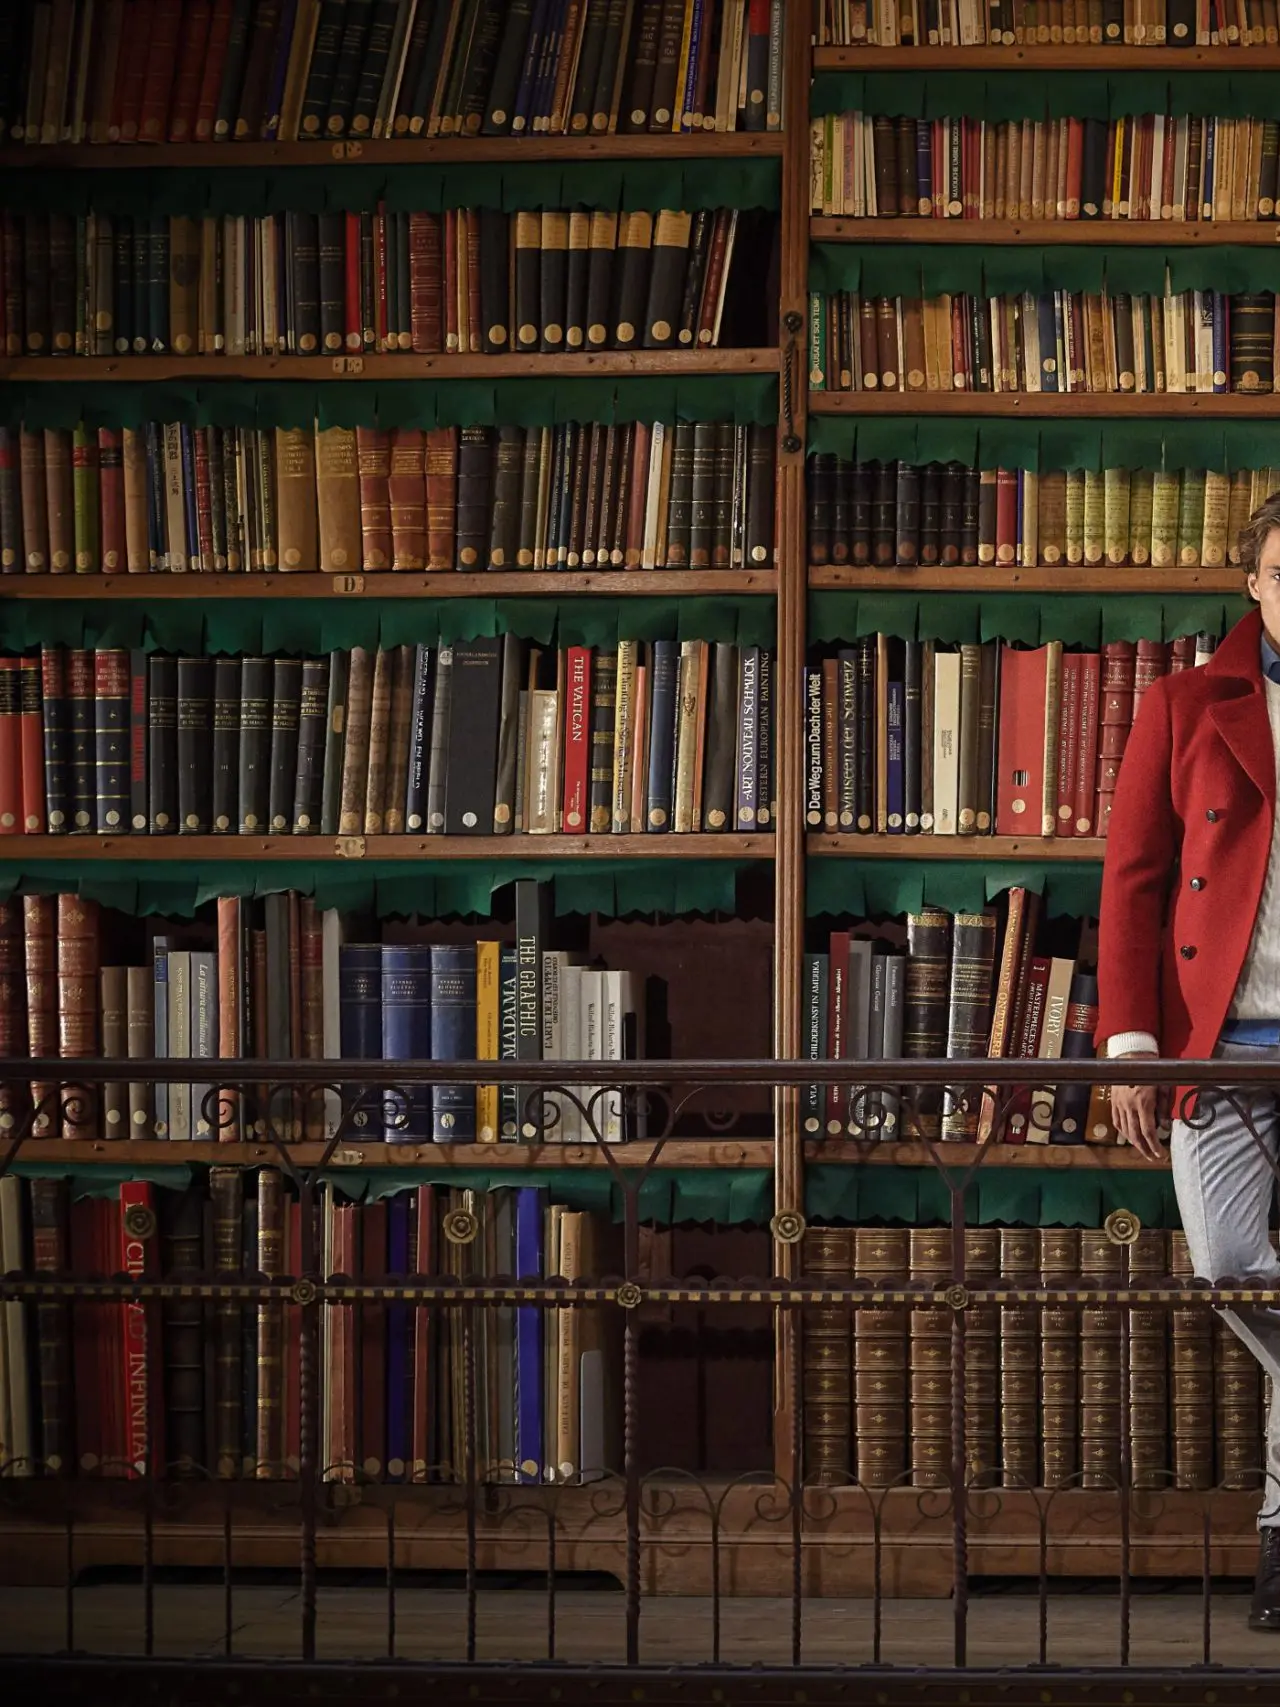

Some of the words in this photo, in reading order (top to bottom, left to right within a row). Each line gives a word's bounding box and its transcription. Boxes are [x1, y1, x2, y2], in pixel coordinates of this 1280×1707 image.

[573, 656, 584, 683] THE
[759, 652, 769, 702] PAINTING
[743, 657, 755, 715] SCHMUCK
[809, 673, 821, 697] Welt
[572, 686, 583, 741] VATICAN
[809, 697, 821, 714] der
[759, 705, 768, 759] EUROPEAN
[808, 714, 821, 742] Dach
[840, 724, 854, 749] der
[742, 718, 754, 772] NOUVEAU
[810, 743, 821, 766] zum
[742, 774, 754, 800] ART
[809, 766, 823, 789] Weg
[808, 789, 821, 809] Der
[520, 935, 536, 965] THE
[199, 964, 208, 977] La
[812, 960, 820, 993] AMERIKA
[198, 977, 208, 1007] pittura
[519, 970, 537, 1036] GRAPHIC
[544, 996, 553, 1016] DEL
[811, 995, 819, 1004] IN
[199, 1007, 208, 1043] emiliana
[502, 976, 517, 1059] MADAMA
[1028, 983, 1043, 1043] MASTERPIECES
[1046, 995, 1064, 1037] IVORY
[811, 1004, 819, 1060] CHILDERKUNST
[199, 1044, 208, 1057] del
[562, 1350, 570, 1375] PARIS
[129, 1352, 146, 1458] INFINITA
